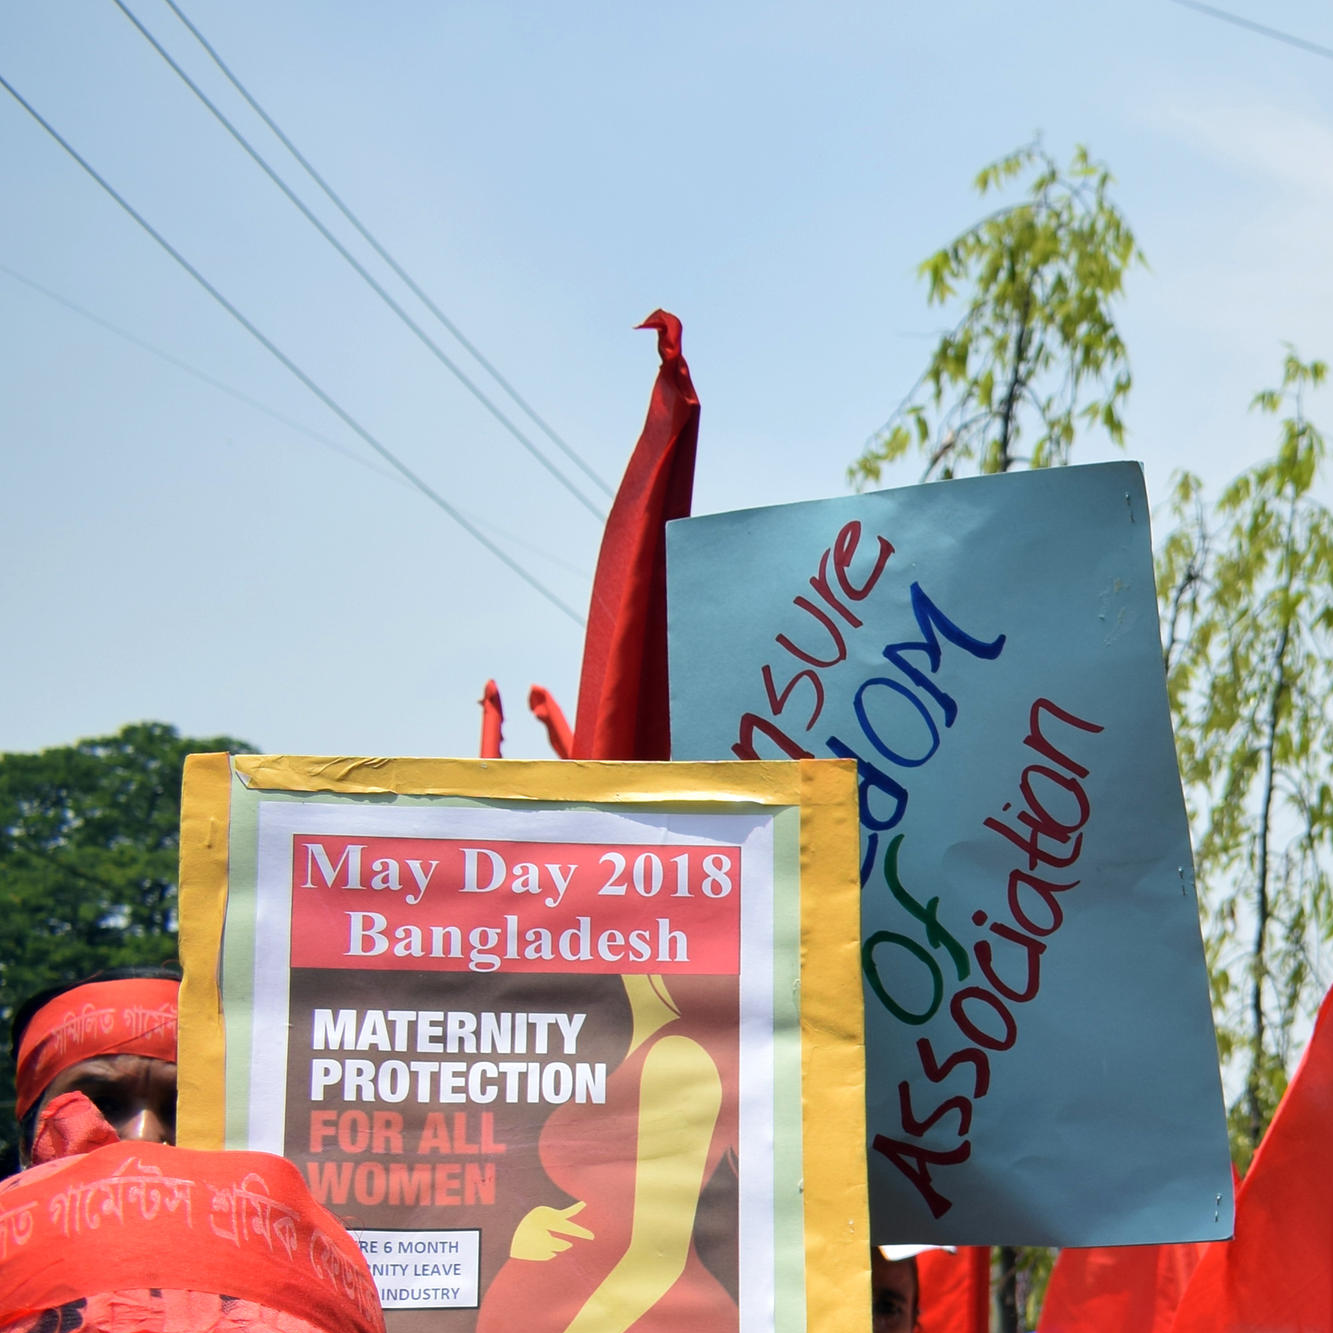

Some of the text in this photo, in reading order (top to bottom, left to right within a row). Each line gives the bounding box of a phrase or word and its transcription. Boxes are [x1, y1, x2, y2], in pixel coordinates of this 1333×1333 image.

[731, 520, 895, 760] nsure
[301, 844, 734, 906] May Day 2018
[344, 911, 690, 972] Bangladesh
[312, 1009, 586, 1055] MATERNITY
[310, 1062, 606, 1104] PROTECTION
[308, 1112, 506, 1155] FOR ALL
[308, 1163, 496, 1206] WOMEN
[383, 1241, 393, 1254] 6
[398, 1240, 459, 1254] MONTH
[413, 1263, 462, 1276] LEAVE
[381, 1287, 460, 1300] INDUSTRY
